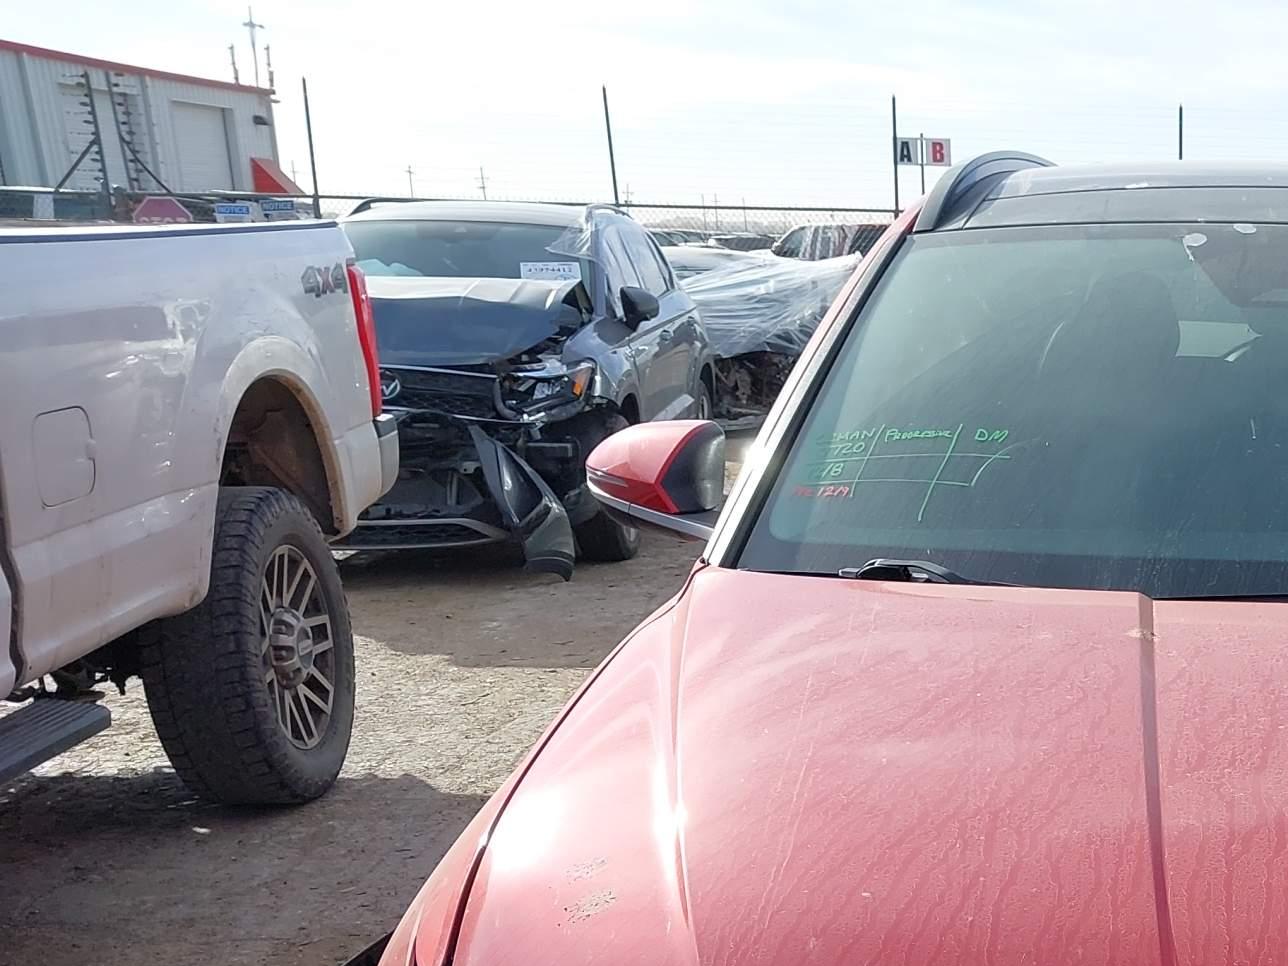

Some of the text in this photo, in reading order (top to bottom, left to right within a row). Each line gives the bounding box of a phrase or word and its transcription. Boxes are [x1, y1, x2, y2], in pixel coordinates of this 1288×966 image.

[899, 140, 911, 163] A
[932, 141, 944, 163] B
[974, 428, 1008, 443] DM
